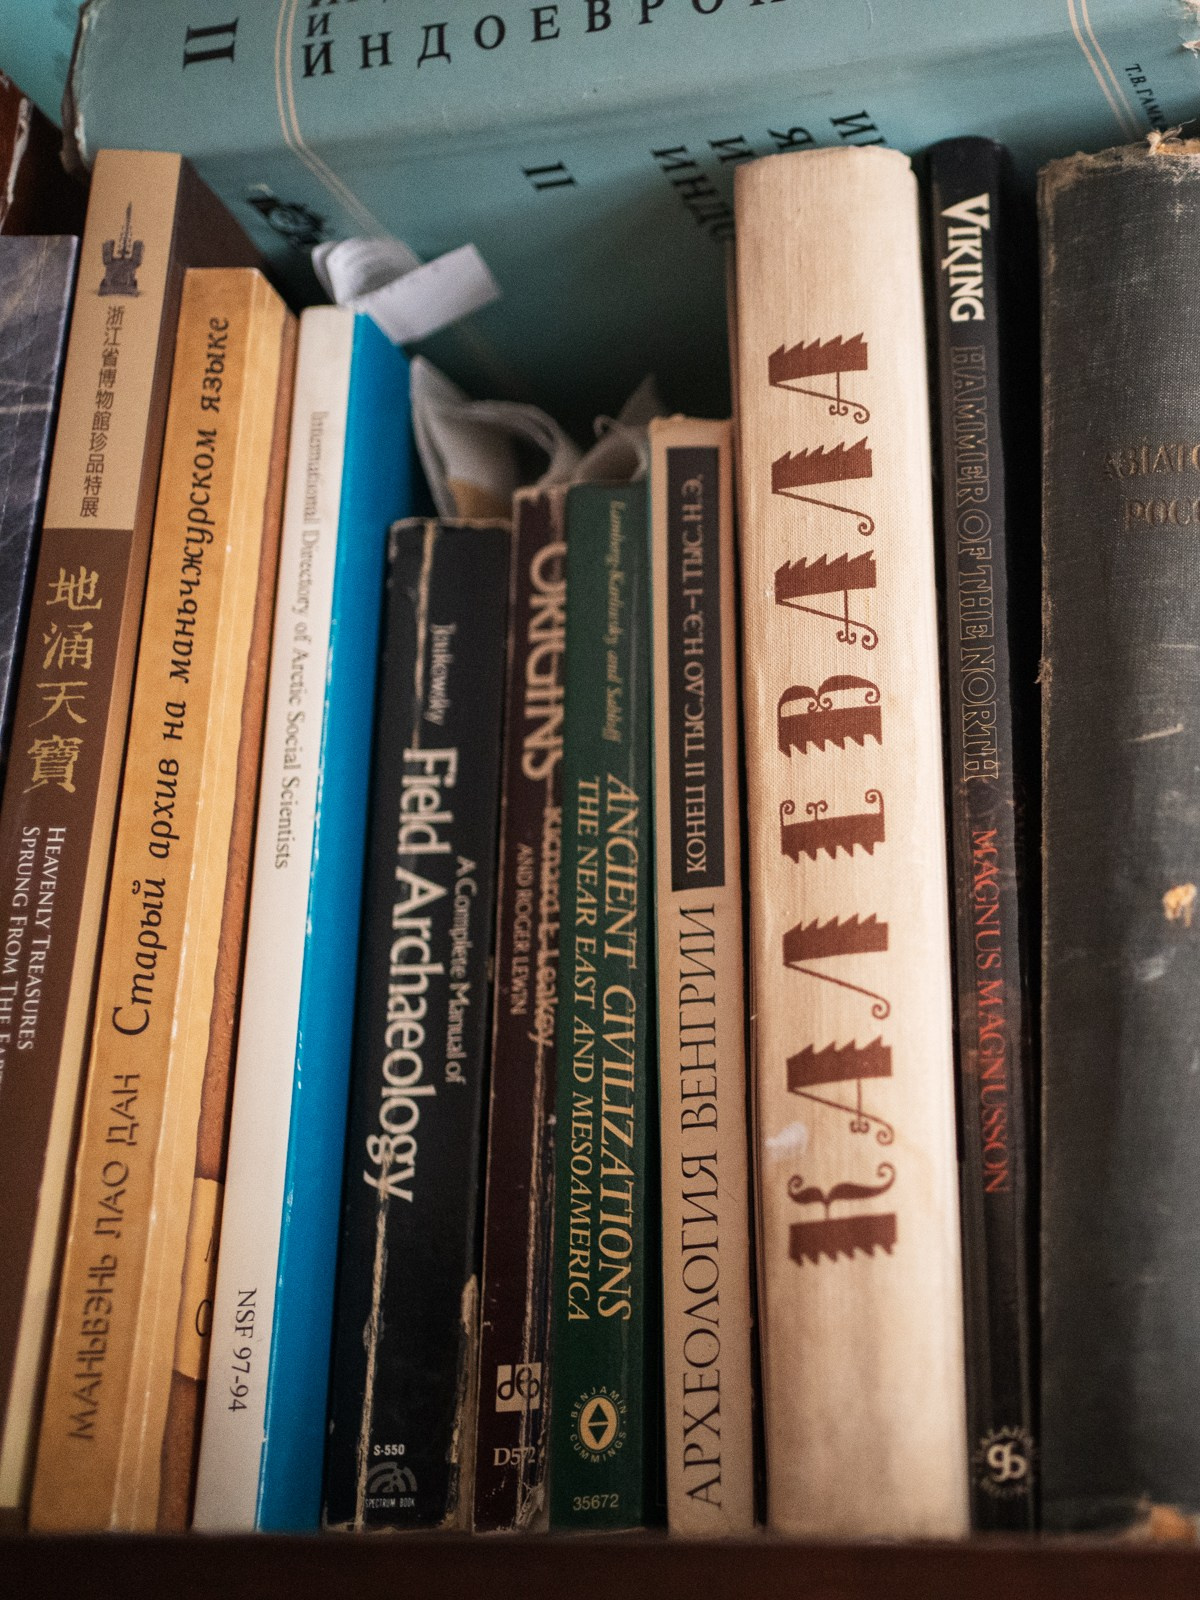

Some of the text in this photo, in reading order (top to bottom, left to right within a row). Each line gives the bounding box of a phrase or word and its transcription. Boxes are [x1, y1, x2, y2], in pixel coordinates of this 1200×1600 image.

[940, 192, 991, 322] VIKING
[80, 305, 126, 518] 浙江省博物館珍品特展
[291, 529, 321, 615] Directory
[957, 508, 992, 560] OF
[293, 620, 311, 643] of
[522, 540, 567, 781] ORIGINS
[958, 564, 995, 641] THE
[112, 316, 230, 1036] Старый архив на маньчжурском языке
[289, 648, 310, 706] Arctic
[960, 645, 999, 783] NORTH
[283, 711, 305, 771] Social
[685, 761, 706, 778] II
[768, 332, 898, 1269] КАЛЕВАЛА
[11, 826, 41, 908] SPRUNG
[274, 776, 300, 870] Scientists
[685, 785, 707, 874] КОНЕЦ
[2, 916, 28, 975] FROM
[17, 827, 66, 1050] HEAVENLY TREASURES
[363, 747, 458, 1203] Field Archaeology
[445, 855, 478, 1085] A Complete Manual of
[510, 842, 534, 1016] AND ROGER LEWIN
[568, 776, 600, 1322] THE NEAR EAST AND MESOAMERICA
[597, 771, 640, 1322] ANCIENT CIVILIZATIONS
[970, 827, 1010, 1195] MAGNUS MAGNUSSON
[66, 1073, 141, 1440] МАНЬВЭНЬ ЛАО ДАН
[679, 903, 722, 1511] АРХЕОЛОГИЯ ВЕНГРИИ
[228, 1287, 258, 1413] NSF 97-94
[571, 1386, 628, 1419] BENJAMIN
[373, 1443, 405, 1456] S-550
[569, 1431, 627, 1464] CUMMINGS
[572, 1493, 620, 1511] 35672
